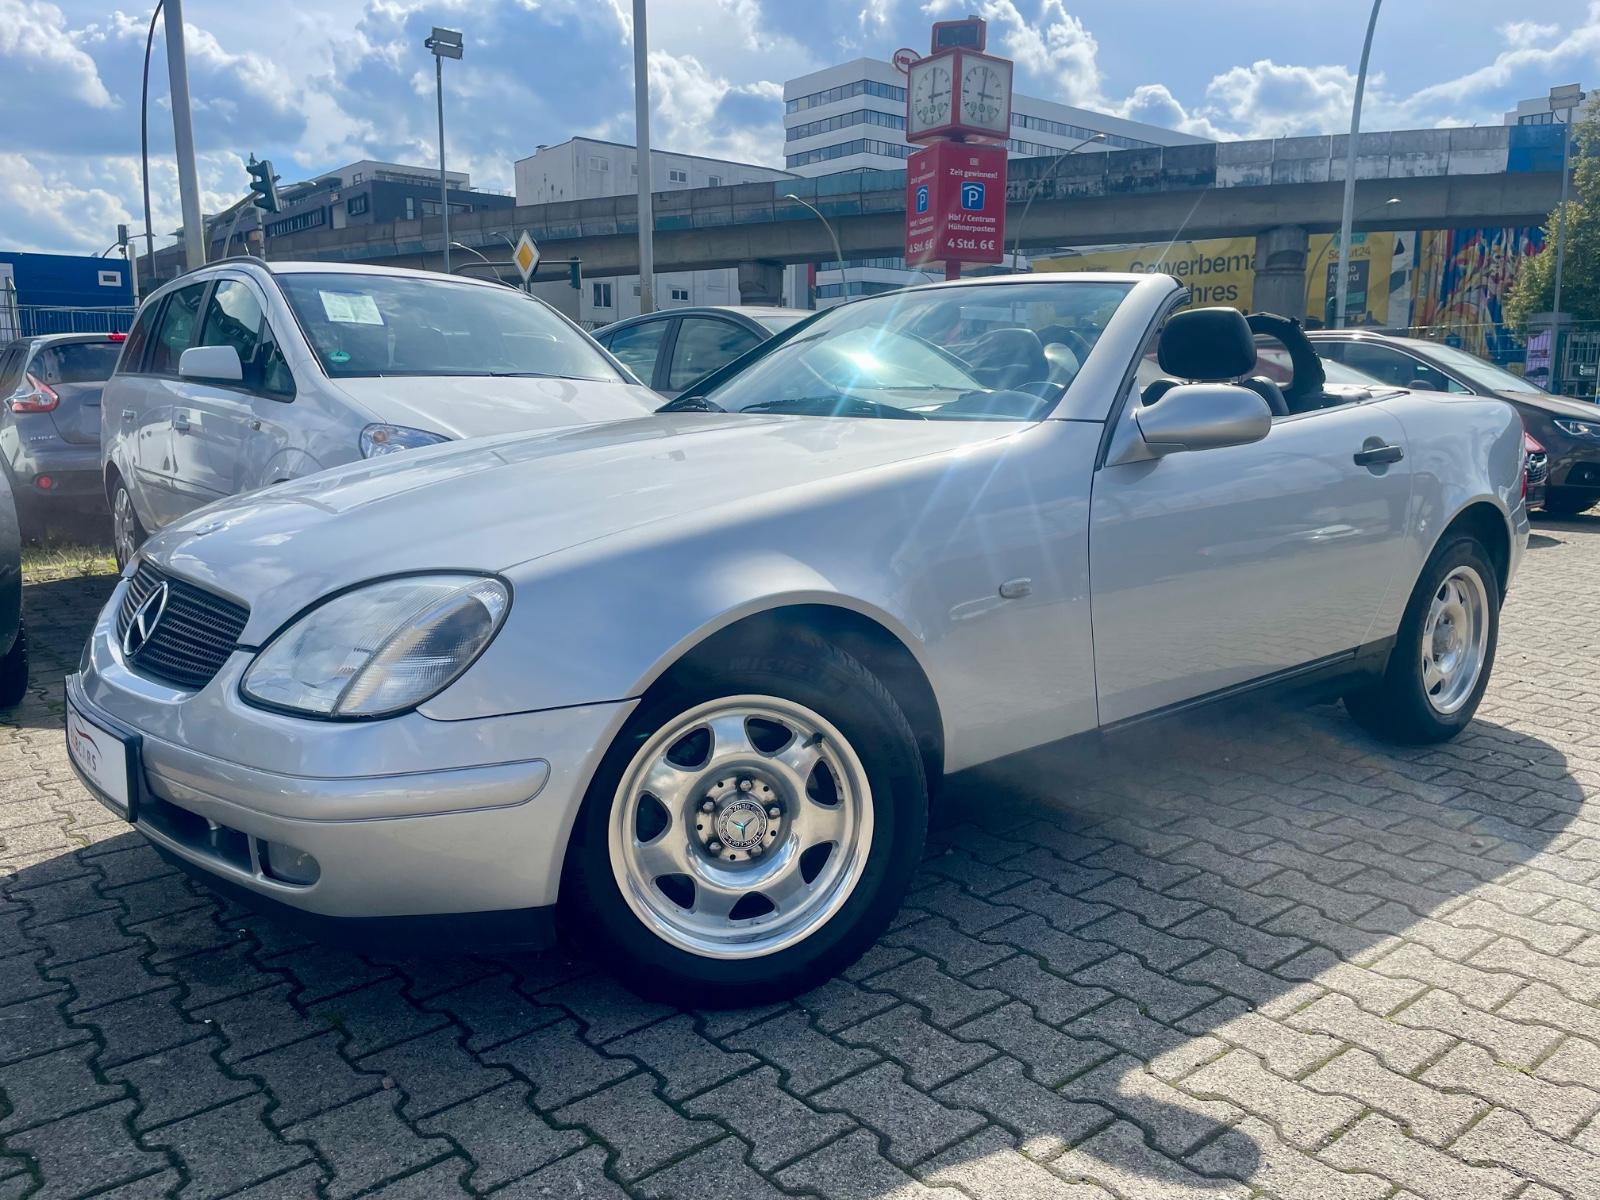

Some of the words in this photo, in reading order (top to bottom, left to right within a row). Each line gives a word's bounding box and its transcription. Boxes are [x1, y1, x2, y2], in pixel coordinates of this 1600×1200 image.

[949, 168, 963, 176] Zeit
[964, 170, 998, 179] gewinnen!
[967, 214, 996, 223] Centrum
[948, 223, 996, 233] Hühnerposten
[947, 238, 955, 248] 4
[957, 238, 978, 249] Std.
[1328, 246, 1371, 260] Scut24
[1329, 265, 1357, 274] Imo
[1329, 273, 1360, 283] Ard
